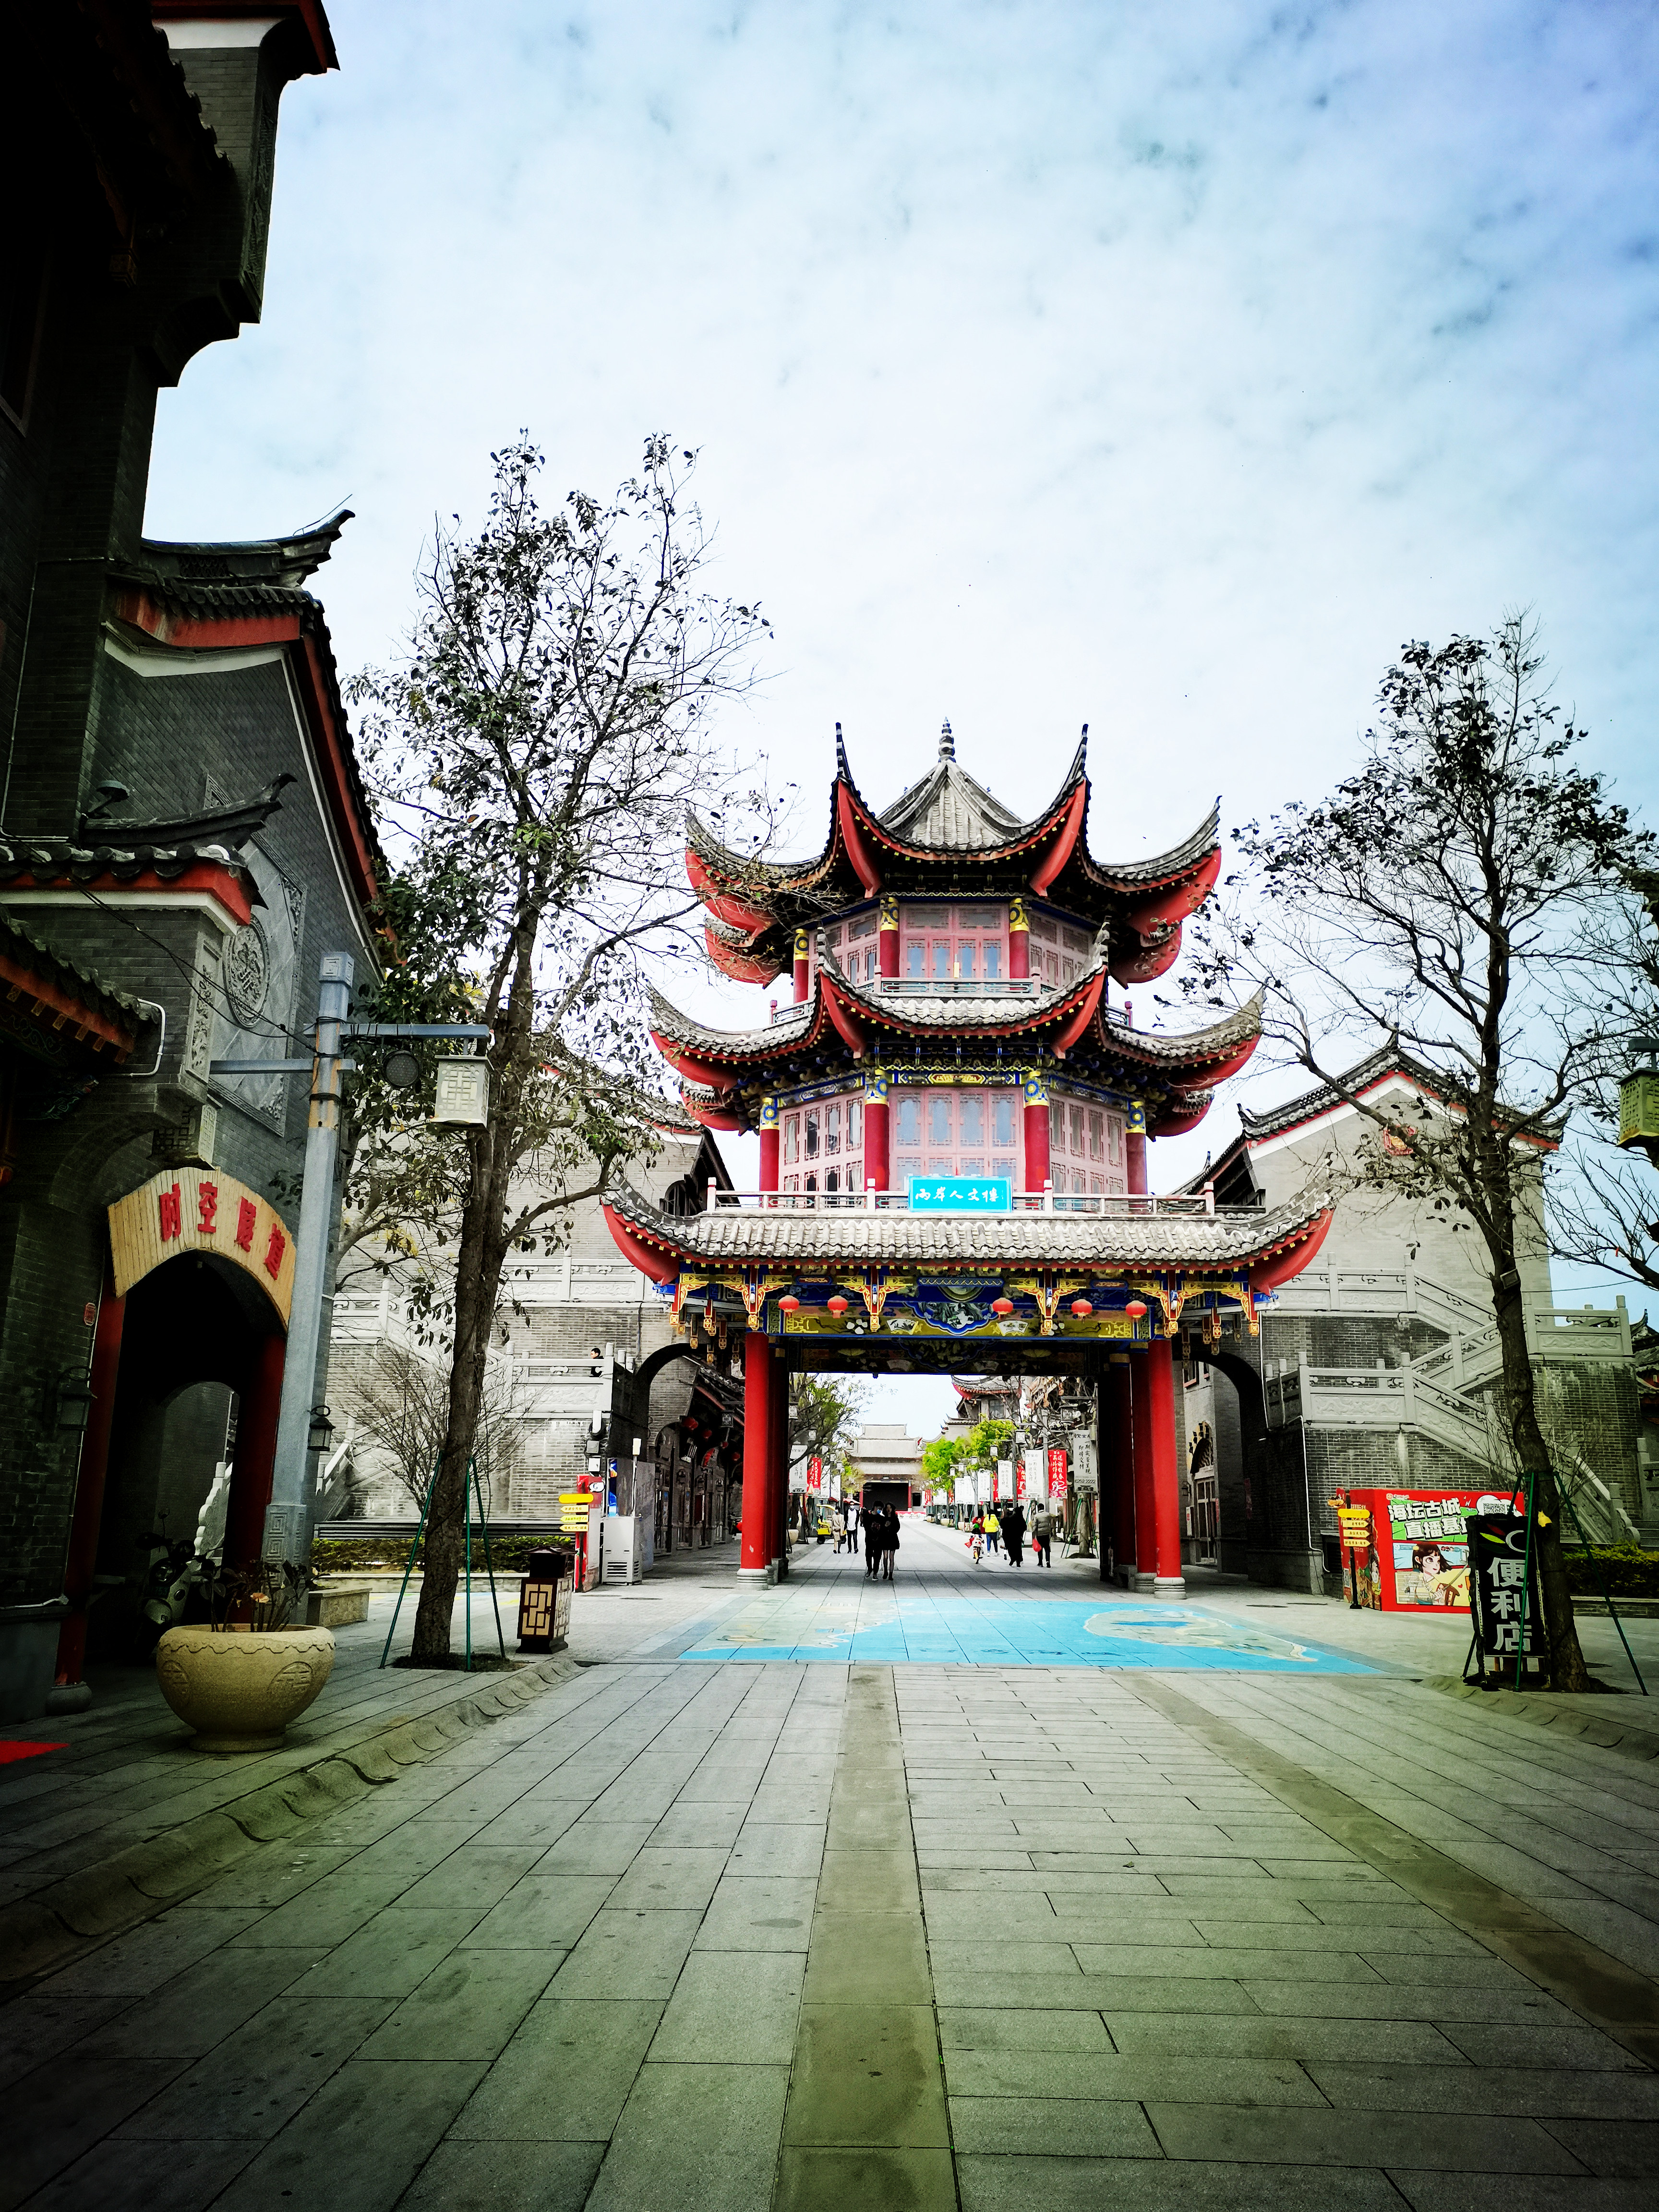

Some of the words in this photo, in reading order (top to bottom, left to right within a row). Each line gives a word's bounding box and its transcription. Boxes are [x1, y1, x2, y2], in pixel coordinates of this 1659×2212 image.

[1387, 1498, 1461, 1522] 海坛古城
[1487, 1557, 1532, 1651] 便利店
